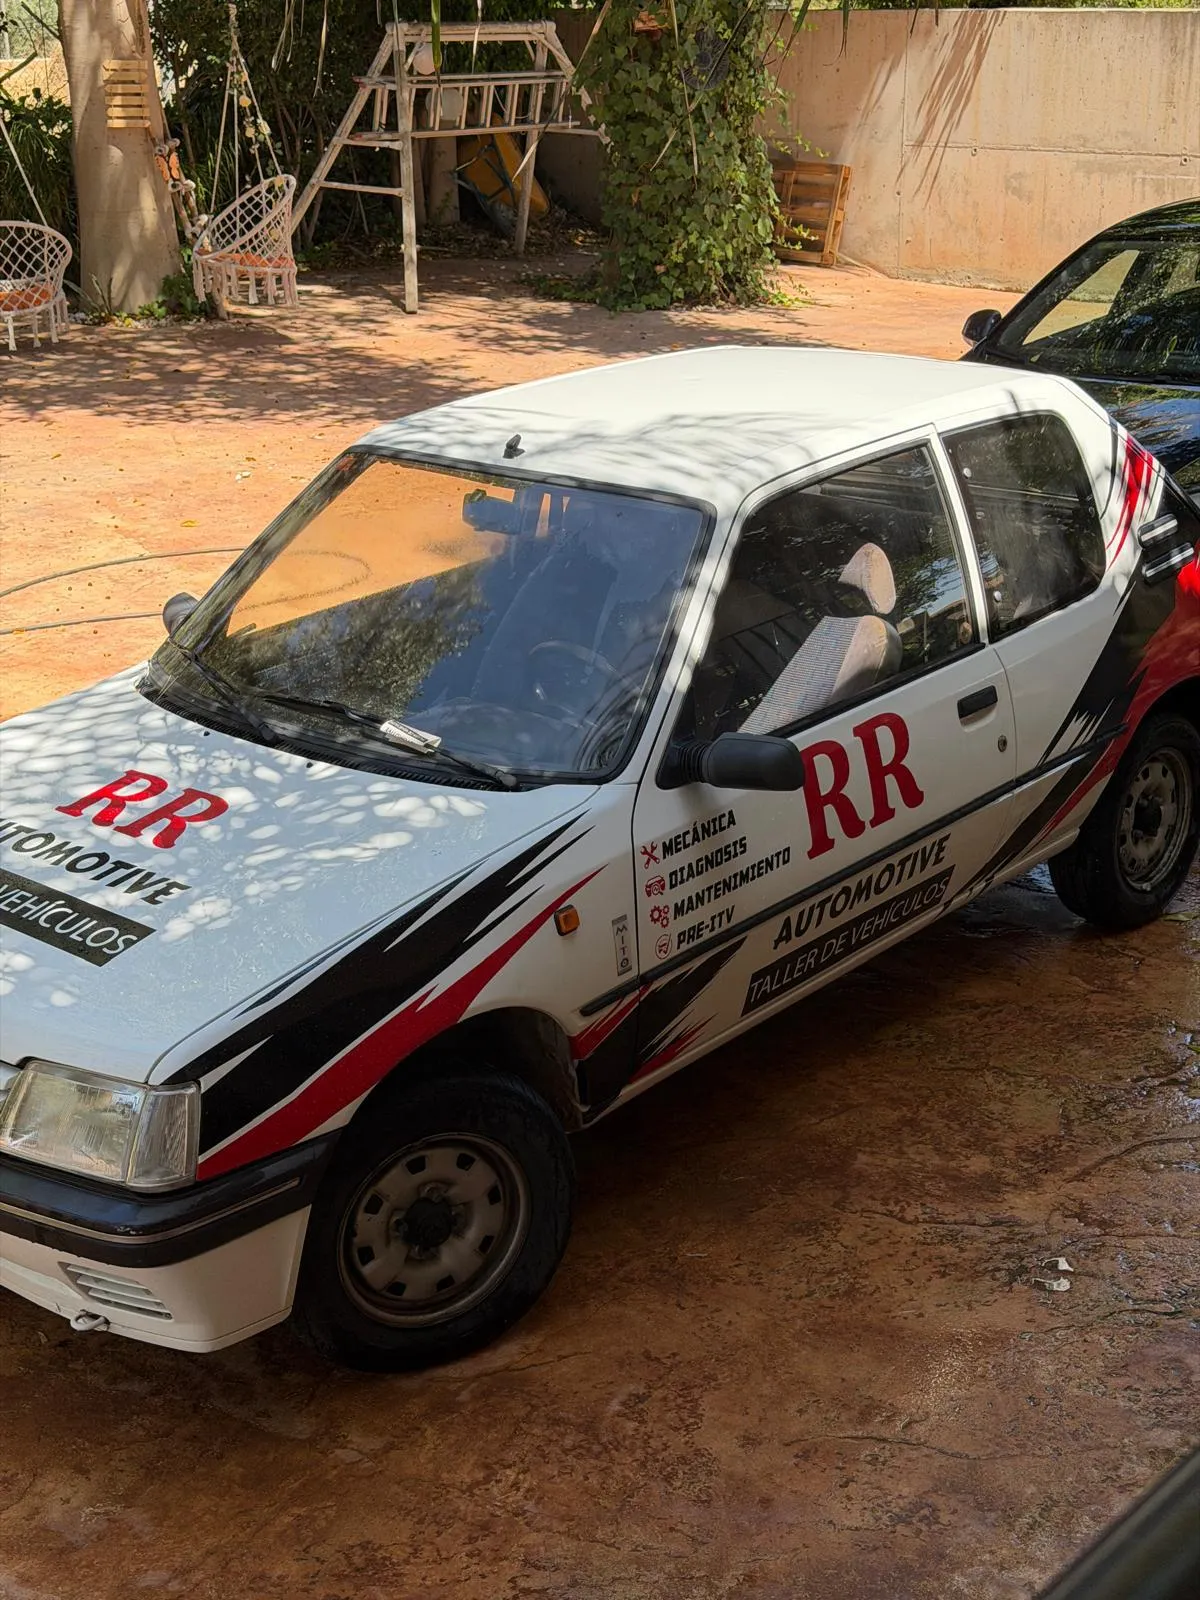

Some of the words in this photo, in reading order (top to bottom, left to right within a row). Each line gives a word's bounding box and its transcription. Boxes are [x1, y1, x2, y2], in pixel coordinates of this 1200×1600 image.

[55, 769, 229, 849] RR
[800, 712, 924, 860] RR
[0, 818, 192, 905] TOMOTIVE
[662, 809, 737, 859] MECÁNICA
[668, 836, 748, 890] DIAGNOSIS
[673, 846, 791, 920] MANTENIMIENTO
[773, 833, 952, 949] AUTOMOTIVE
[676, 905, 735, 950] PRE-ITV
[750, 948, 819, 1004] TALLER
[820, 936, 848, 963] DE
[851, 877, 949, 947] VEHÍCULOS
